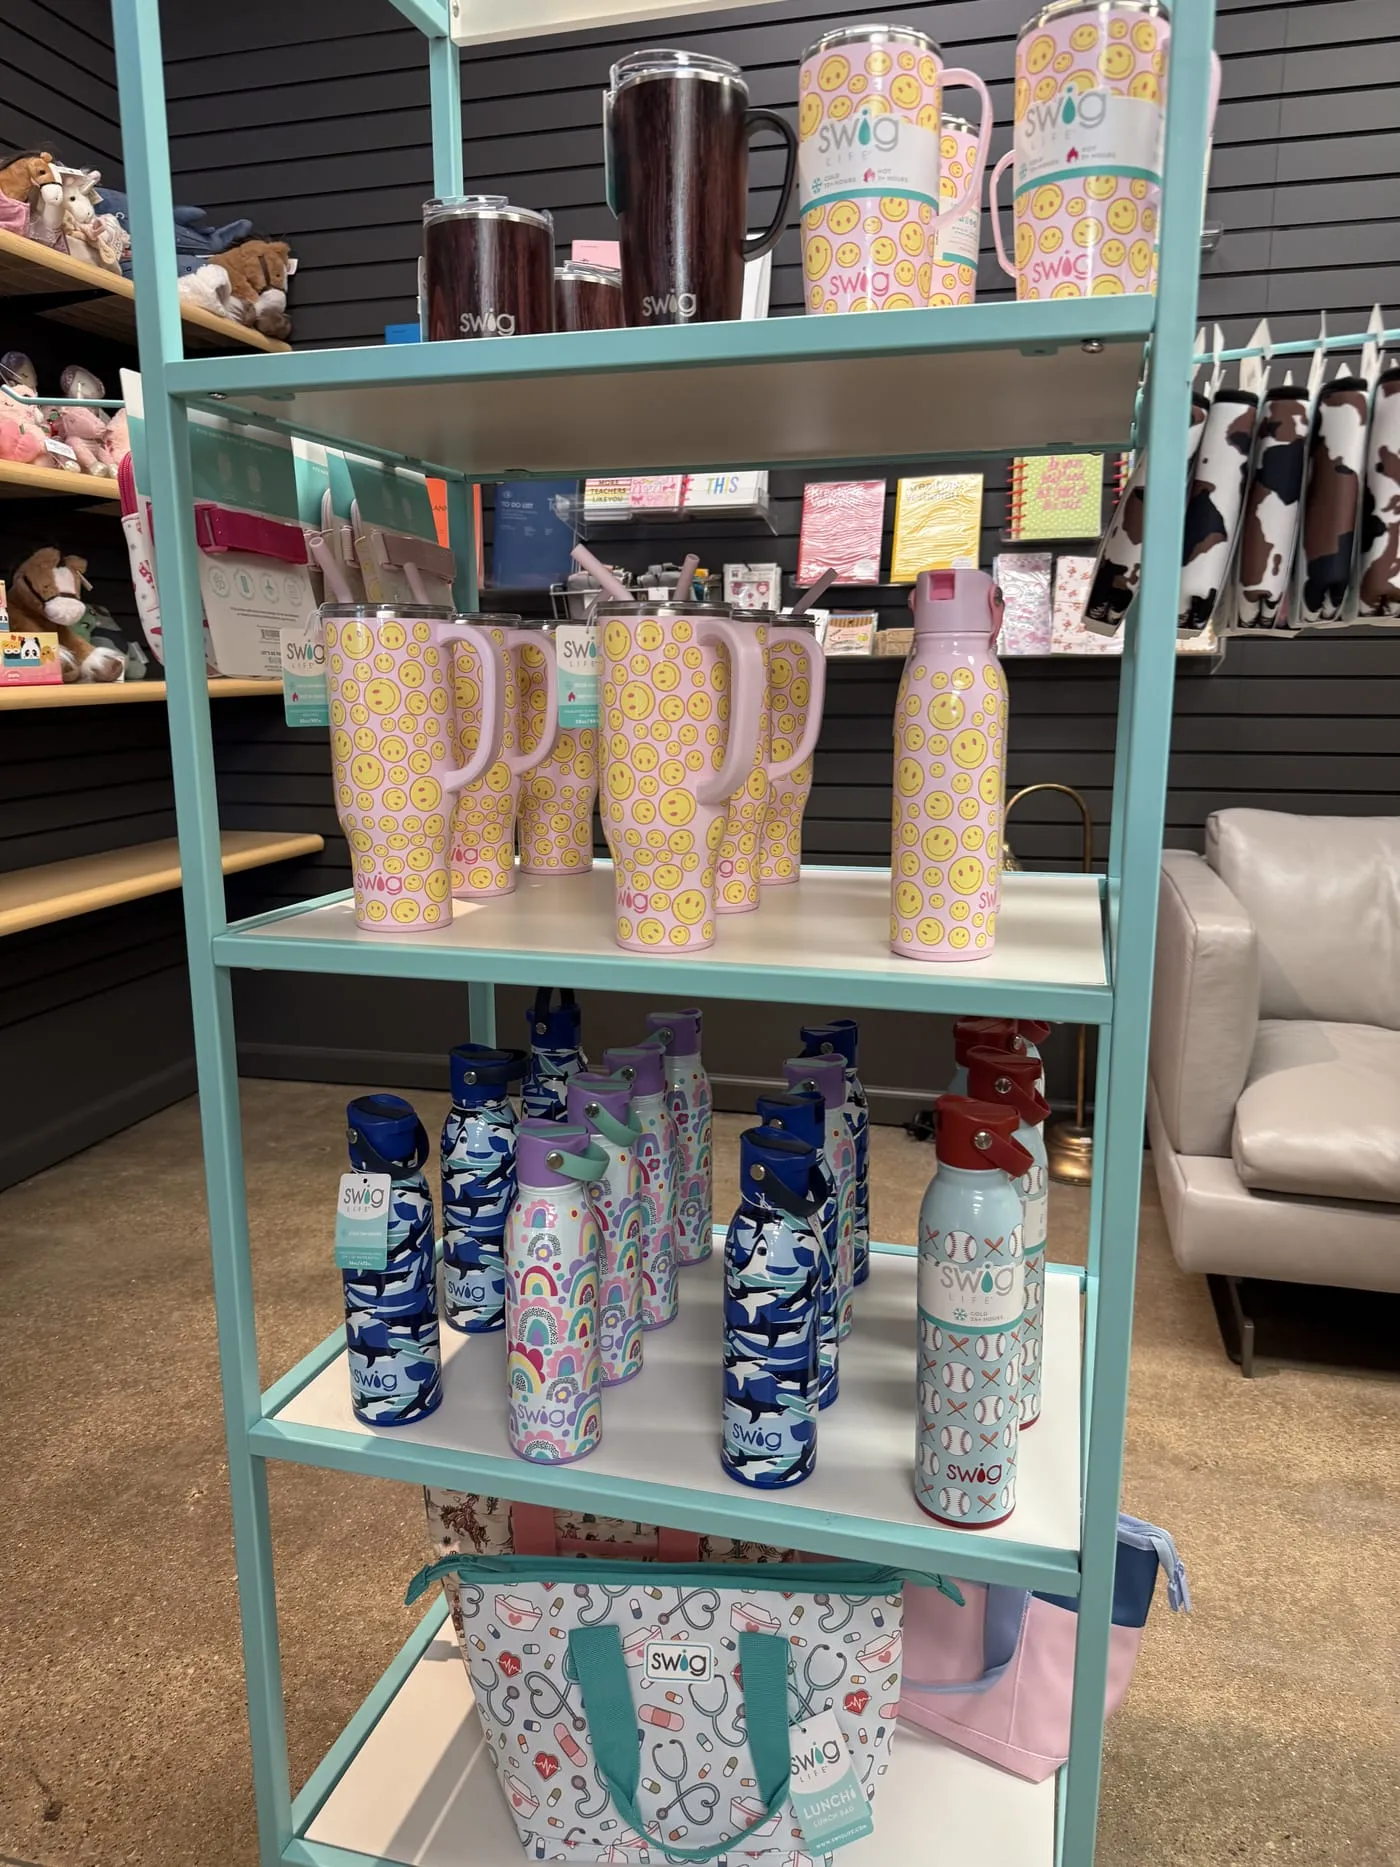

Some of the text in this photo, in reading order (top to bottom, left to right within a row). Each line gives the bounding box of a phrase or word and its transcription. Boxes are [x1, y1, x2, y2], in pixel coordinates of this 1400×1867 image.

[1025, 86, 1106, 137] swig
[818, 109, 899, 153] swig
[829, 266, 889, 297] swig
[642, 288, 697, 317] swig
[459, 307, 516, 336] swig
[706, 476, 740, 495] THIS
[287, 639, 326, 664] swig
[563, 636, 597, 658] swi
[357, 872, 403, 895] swig
[344, 1184, 385, 1208] swig
[448, 1281, 486, 1302] swig
[941, 1264, 1014, 1296] swig
[354, 1369, 398, 1392] swig
[518, 1404, 566, 1428] swig
[732, 1422, 782, 1451] swig
[946, 1462, 1002, 1485] swig
[651, 1649, 707, 1677] swig
[791, 1741, 841, 1775] swig
